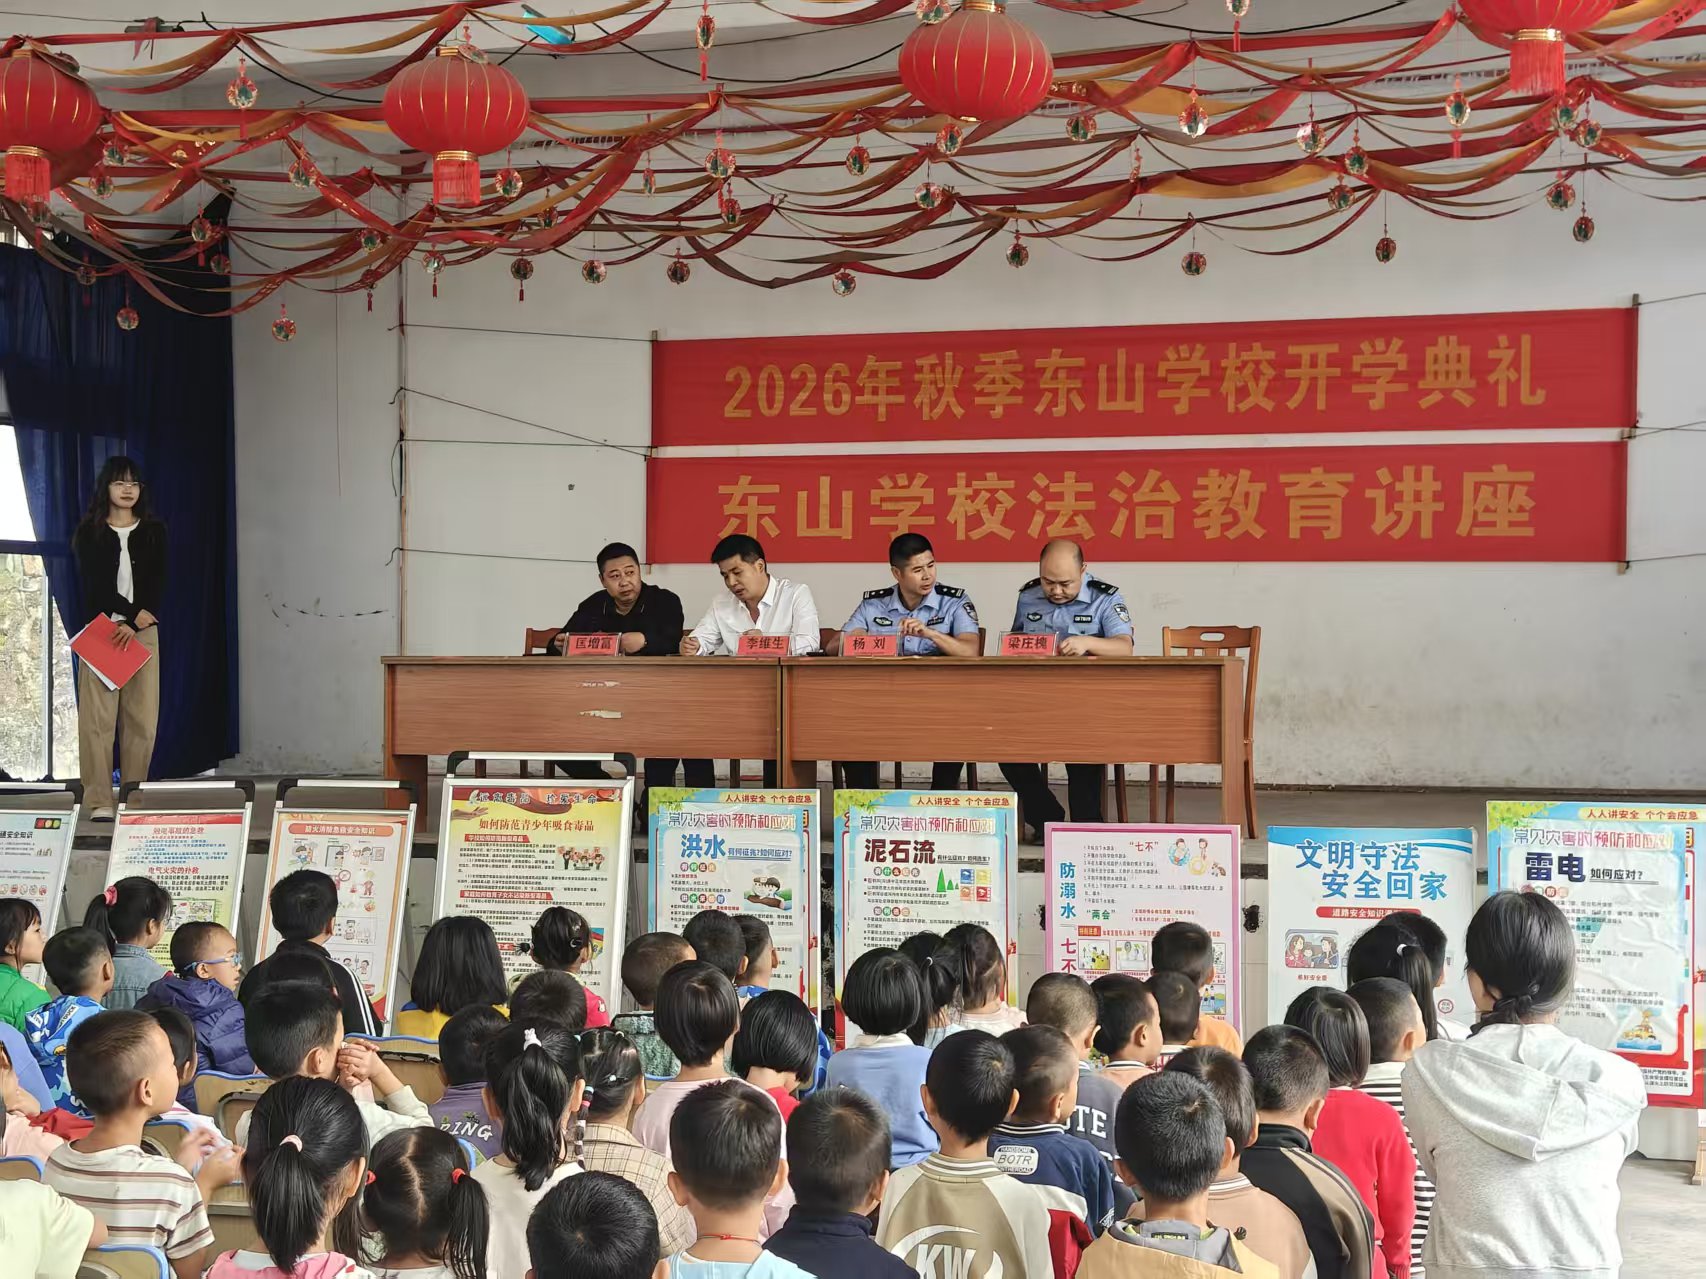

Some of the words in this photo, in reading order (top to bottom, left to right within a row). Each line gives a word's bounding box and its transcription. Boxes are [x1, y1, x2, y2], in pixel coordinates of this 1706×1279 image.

[724, 333, 1547, 422] 2026年秋季东山学校开学典礼
[718, 464, 1536, 543] 东山学校法治教育讲座
[746, 636, 784, 649] 李维生
[726, 794, 767, 803] 人人讲安全
[771, 794, 812, 803] 个个会应急
[917, 797, 960, 806] 人人讲安全
[965, 798, 1010, 806] 个个会应急
[479, 818, 594, 832] 如何防范青少年吸食毒品
[668, 812, 796, 831] 常见灾害的预防和应对
[860, 815, 995, 834] 常见灾害的预防和应对
[1587, 809, 1640, 820] 人人讲安全
[1646, 810, 1699, 821] 个个会应急
[680, 833, 726, 859] 洪水
[1513, 828, 1675, 849] 常见灾害的预防和应对
[864, 838, 935, 864] 泥石流
[1295, 839, 1421, 871] 文明守法
[1525, 852, 1586, 883] 雷电
[1590, 868, 1644, 881] 如何应对?
[1059, 862, 1077, 920] 防溺水
[1321, 870, 1448, 901] 安全回家
[1332, 908, 1400, 918] 道路安全知识
[1065, 1104, 1107, 1139] TE
[997, 1154, 1032, 1165] BOTR
